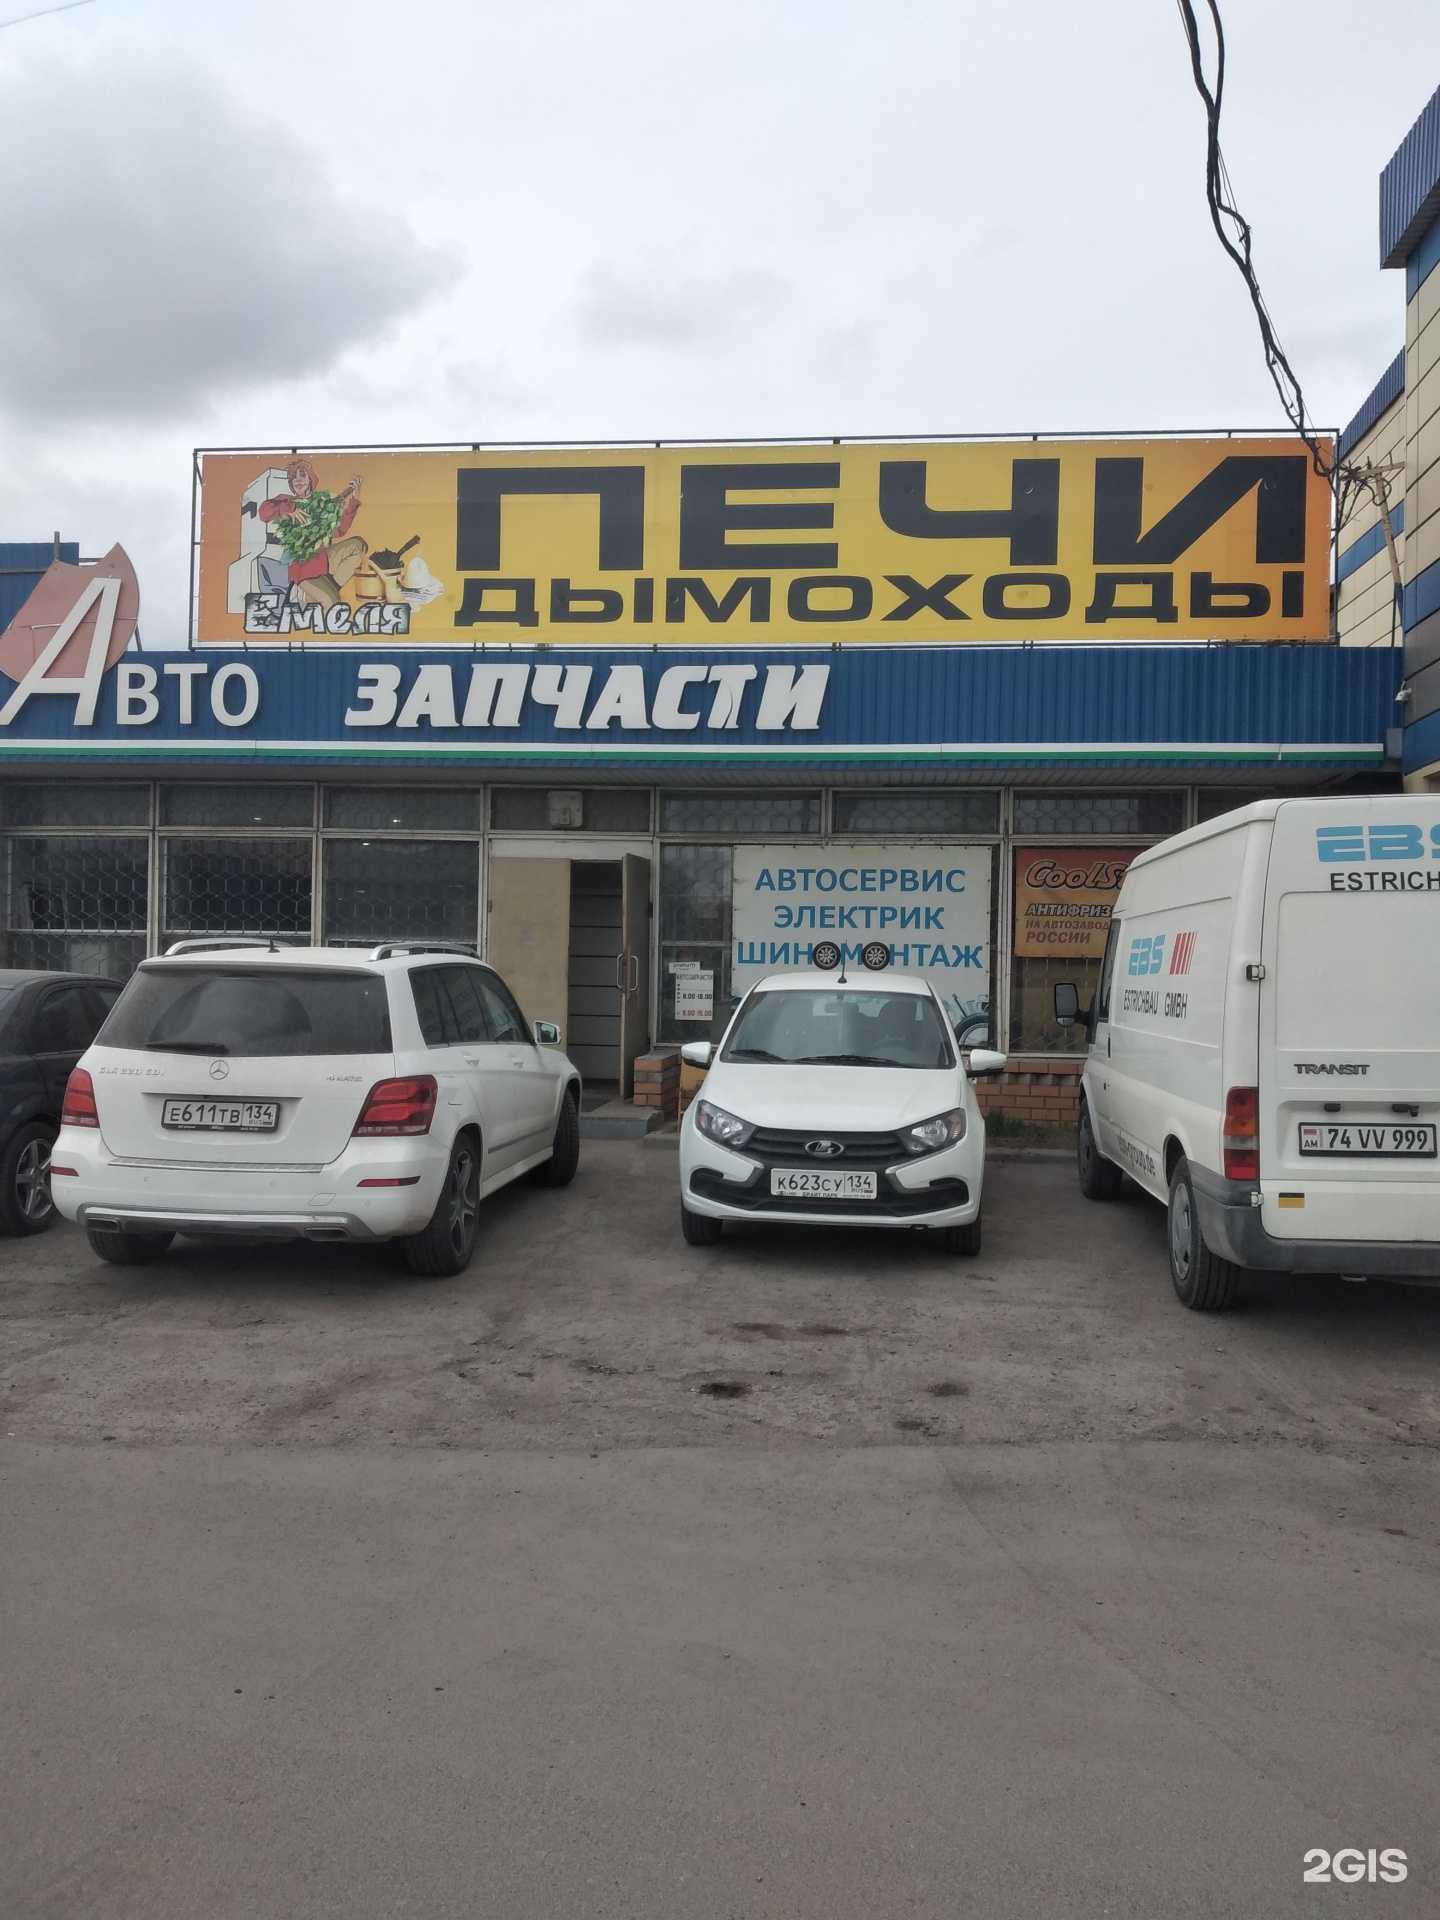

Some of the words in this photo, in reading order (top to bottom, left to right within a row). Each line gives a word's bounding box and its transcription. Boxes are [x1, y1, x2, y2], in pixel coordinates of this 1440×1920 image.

[457, 456, 1307, 571] ПЕЧИ
[454, 570, 1304, 626] ДЫМОХОДЫ
[344, 664, 831, 731] ЗАПЧАСТИ
[755, 868, 966, 893] АВТОСЕРВИС
[774, 905, 945, 930] ЭЛЕКТРИК
[1024, 903, 1113, 918] АНТИФРИЗ
[1026, 931, 1090, 944] РОССИИ
[1128, 934, 1166, 976] EBS
[1123, 988, 1159, 1015] ESTRICHBAU
[1164, 991, 1188, 1019] GMBH
[1293, 1063, 1370, 1075] TRANSIT
[1304, 1139, 1318, 1148] AM
